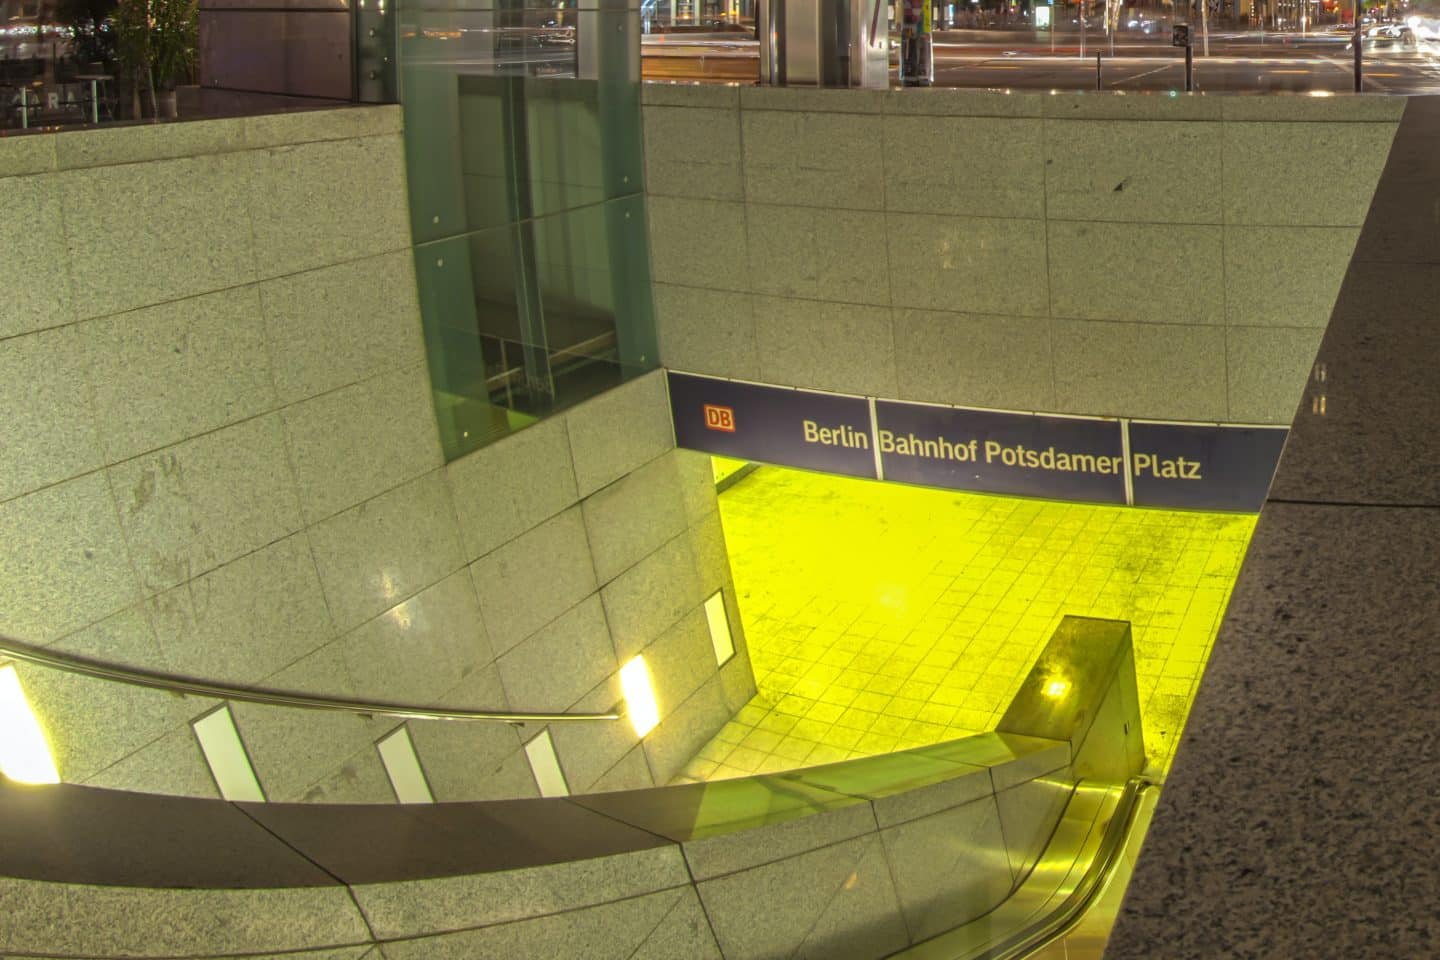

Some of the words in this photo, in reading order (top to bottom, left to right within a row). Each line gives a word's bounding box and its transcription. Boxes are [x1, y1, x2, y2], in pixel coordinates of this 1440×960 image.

[707, 407, 733, 429] DB
[803, 420, 869, 450] Berlin
[879, 430, 978, 462] Bahnhof
[985, 440, 1122, 475] Potsdamer
[1133, 453, 1202, 479] Platz
